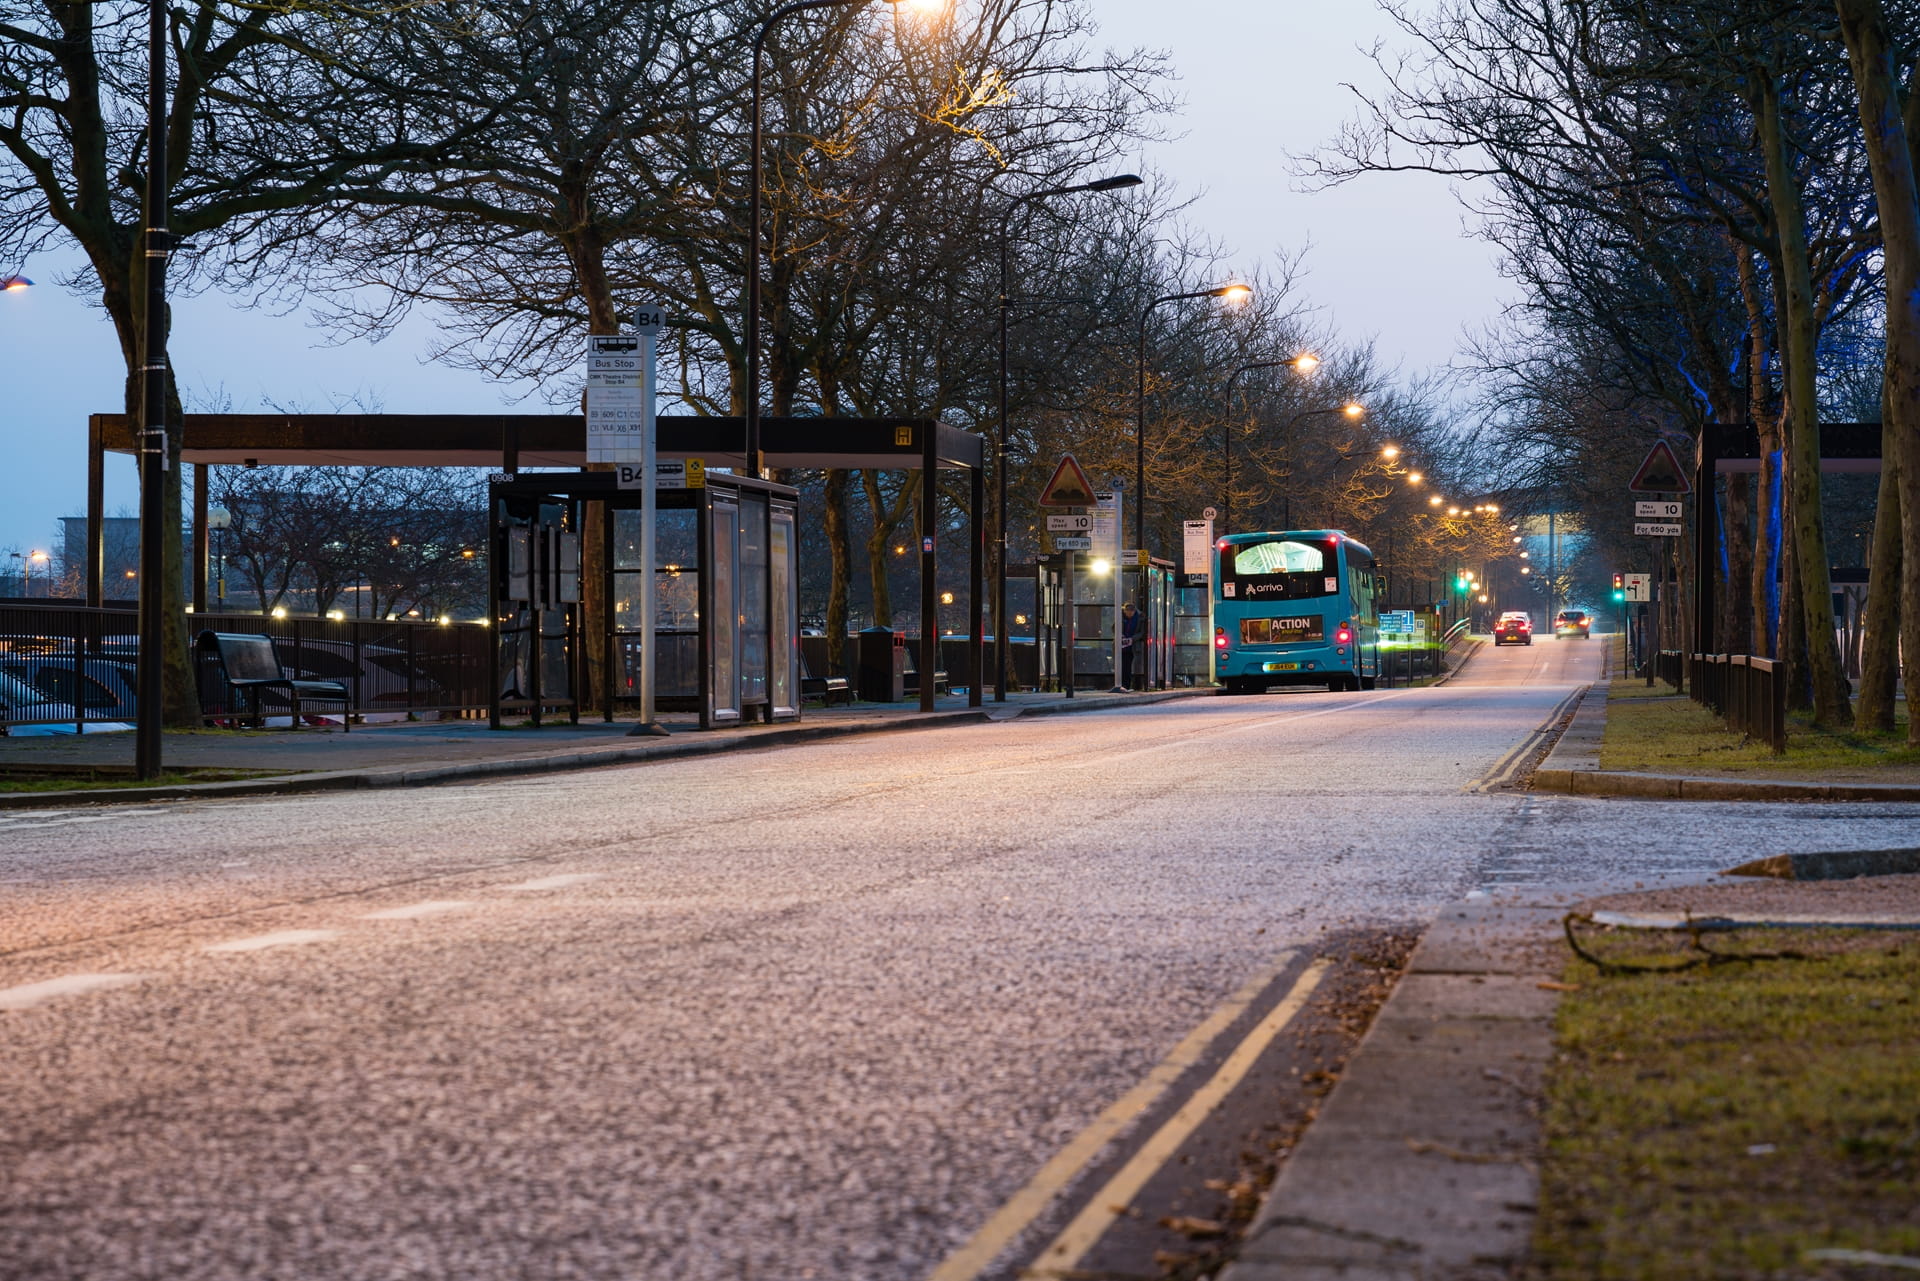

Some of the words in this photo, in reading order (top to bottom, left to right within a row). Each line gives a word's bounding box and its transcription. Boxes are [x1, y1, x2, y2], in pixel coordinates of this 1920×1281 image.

[639, 312, 660, 326] B4
[595, 359, 611, 368] Bus
[614, 359, 635, 368] Stop
[491, 474, 514, 482] 0908
[1664, 505, 1678, 514] 10
[1074, 517, 1088, 528] 10
[1256, 583, 1284, 592] arriva
[1272, 618, 1310, 630] ACTION
